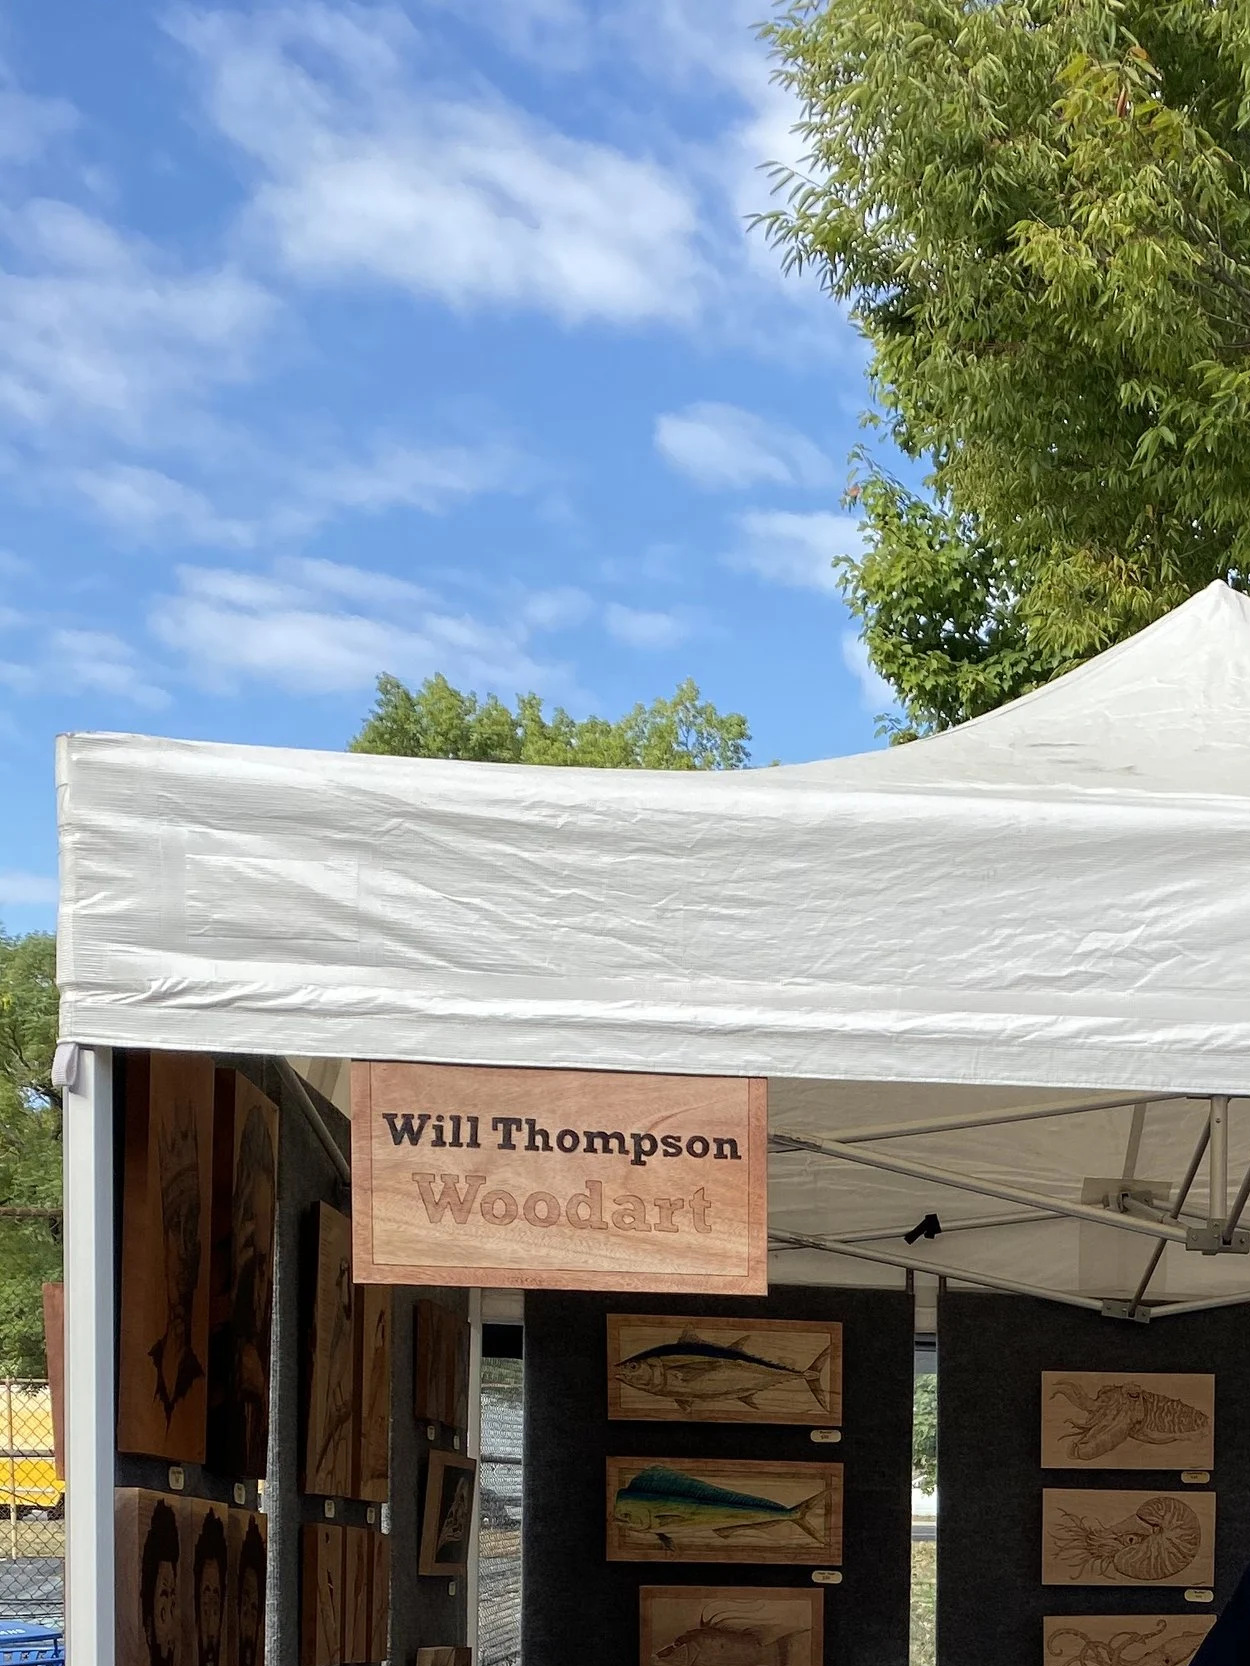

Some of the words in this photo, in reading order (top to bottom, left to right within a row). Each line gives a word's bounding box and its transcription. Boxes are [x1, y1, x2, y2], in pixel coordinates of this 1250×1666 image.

[382, 1112, 481, 1149] Will
[491, 1116, 742, 1166] Thompson
[411, 1171, 713, 1234] Woodart
